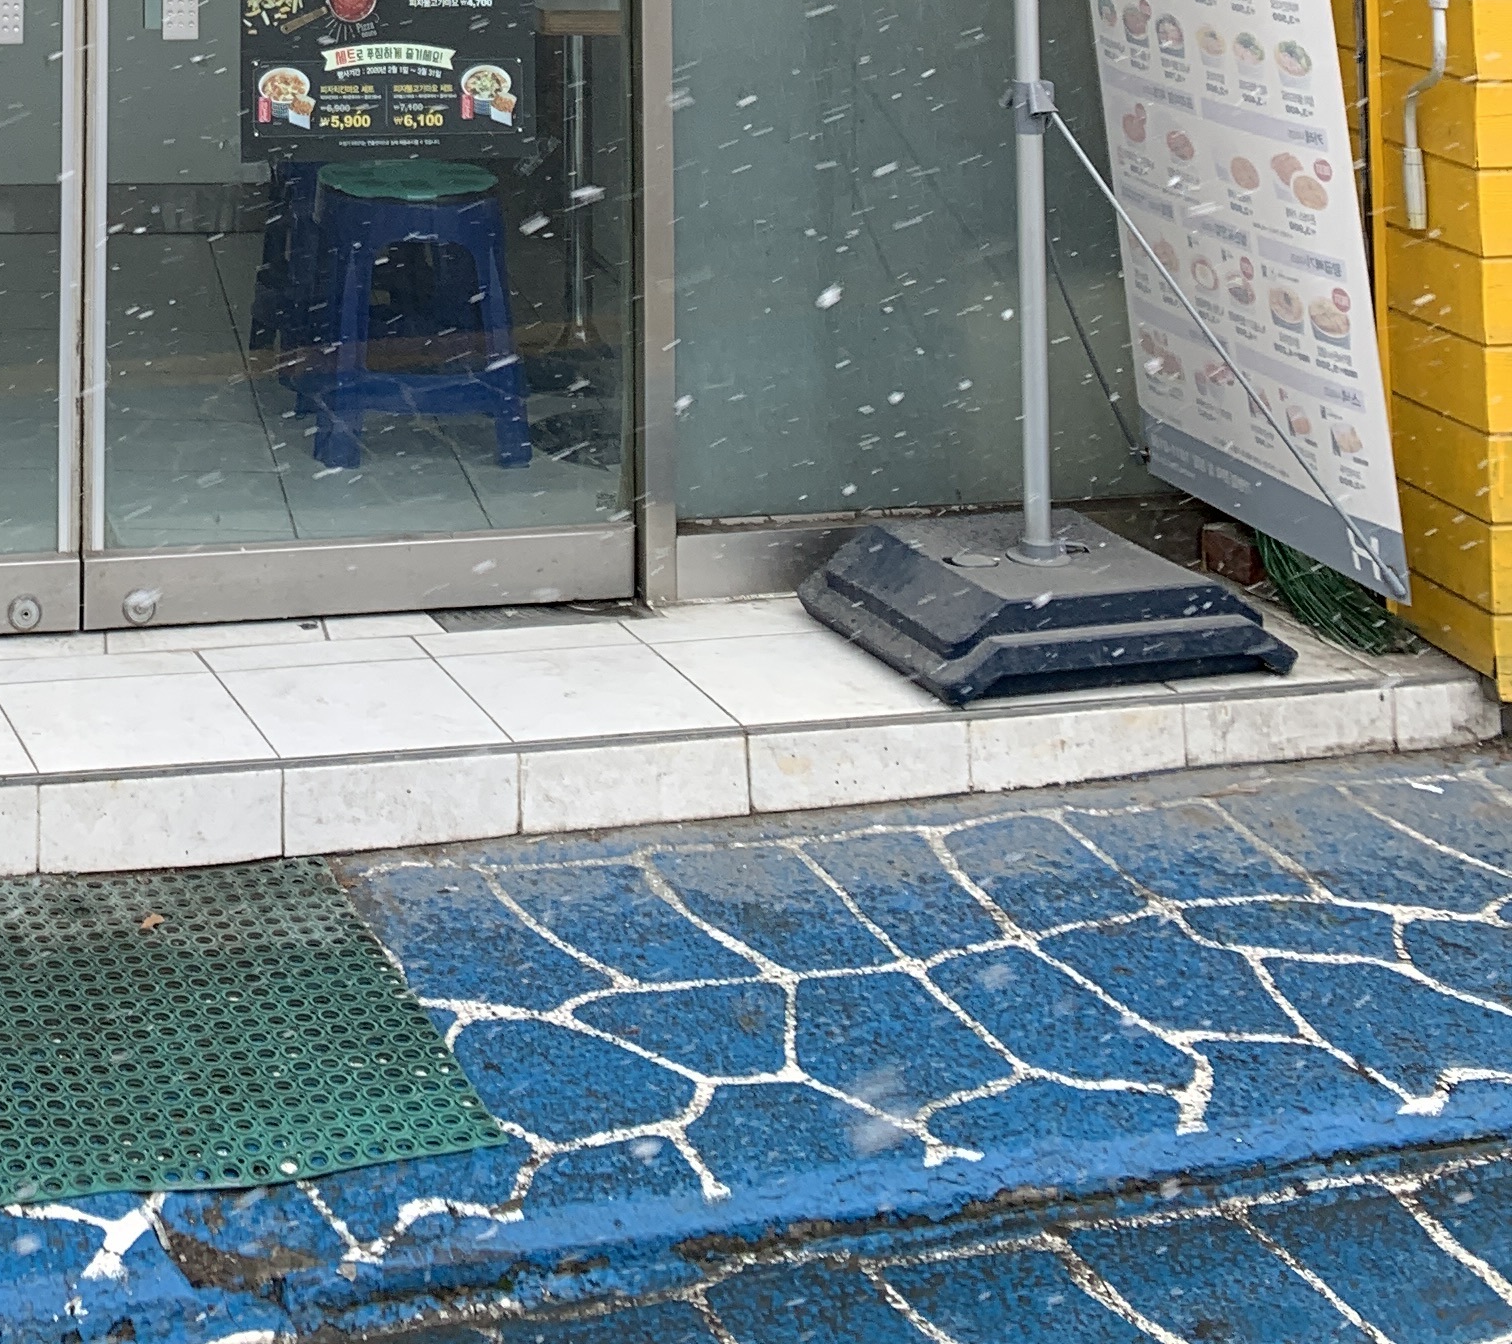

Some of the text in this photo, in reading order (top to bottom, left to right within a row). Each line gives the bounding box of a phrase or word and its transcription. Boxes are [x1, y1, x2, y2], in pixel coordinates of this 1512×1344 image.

[335, 47, 444, 66] 세트로 푸짐하게 즐기세요!
